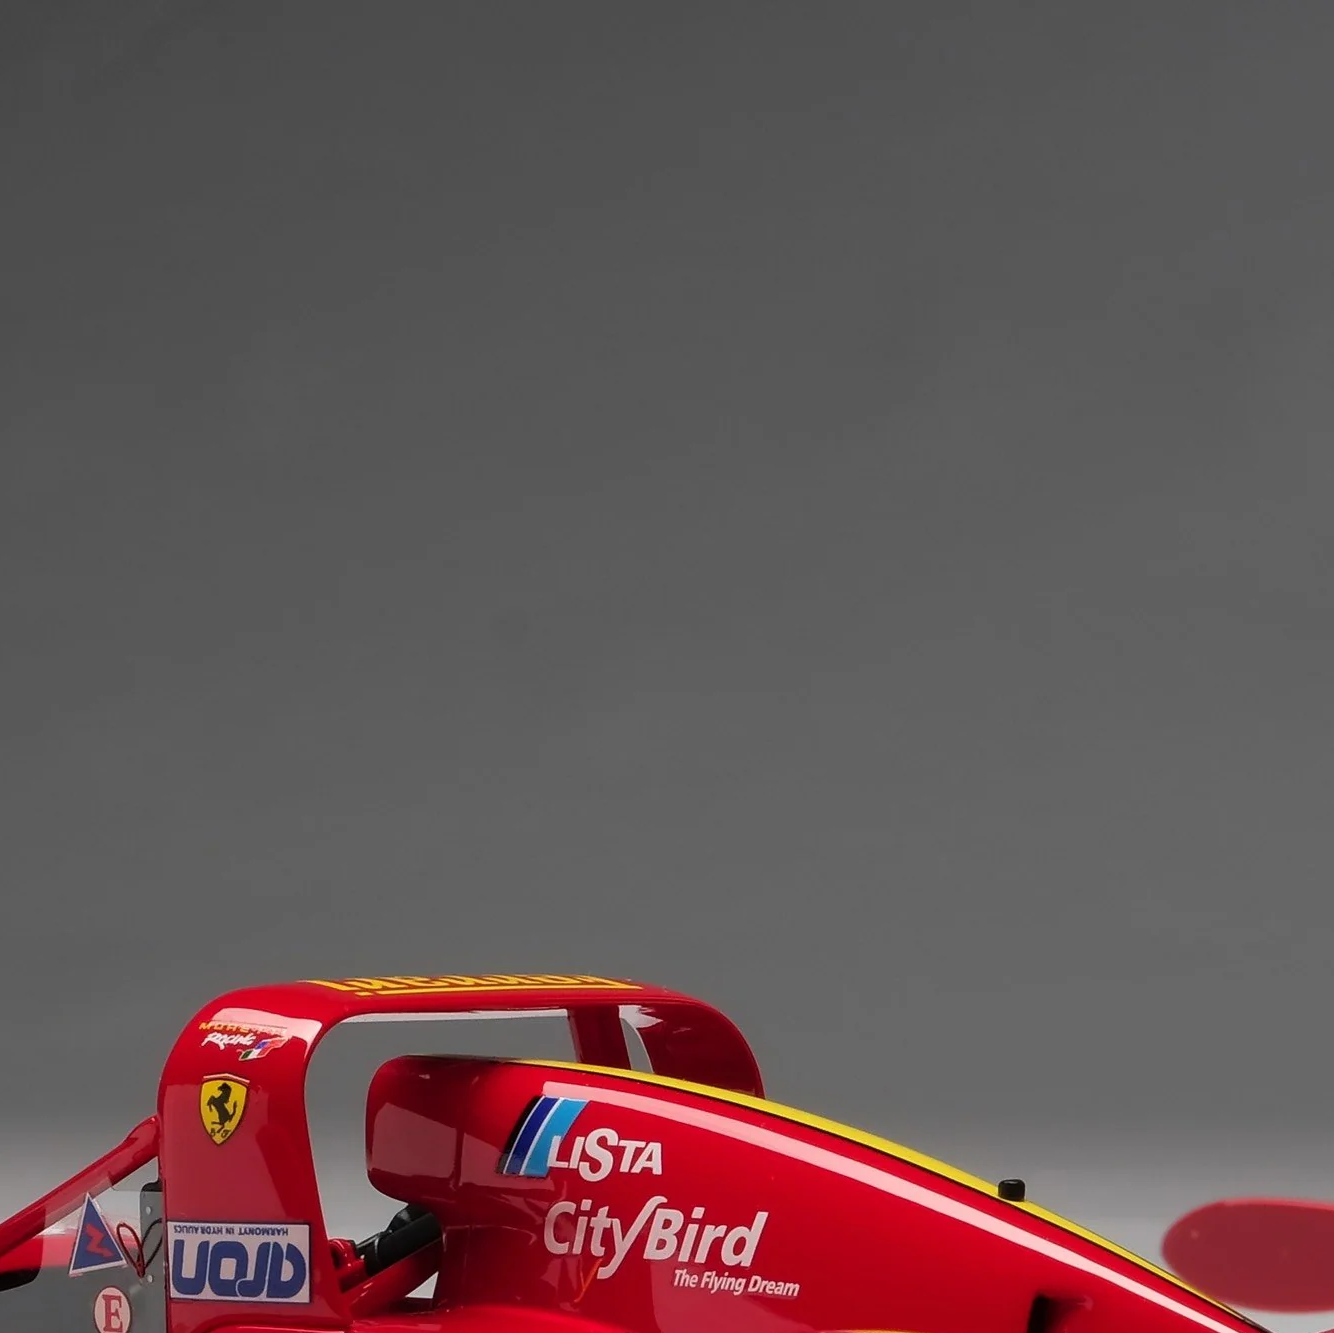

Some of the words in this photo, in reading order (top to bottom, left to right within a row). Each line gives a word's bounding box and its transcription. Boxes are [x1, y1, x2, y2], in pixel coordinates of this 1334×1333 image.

[674, 1269, 698, 1288] The
[700, 1270, 746, 1296] Flying
[748, 1275, 800, 1297] Dream
[101, 1294, 123, 1333] E
